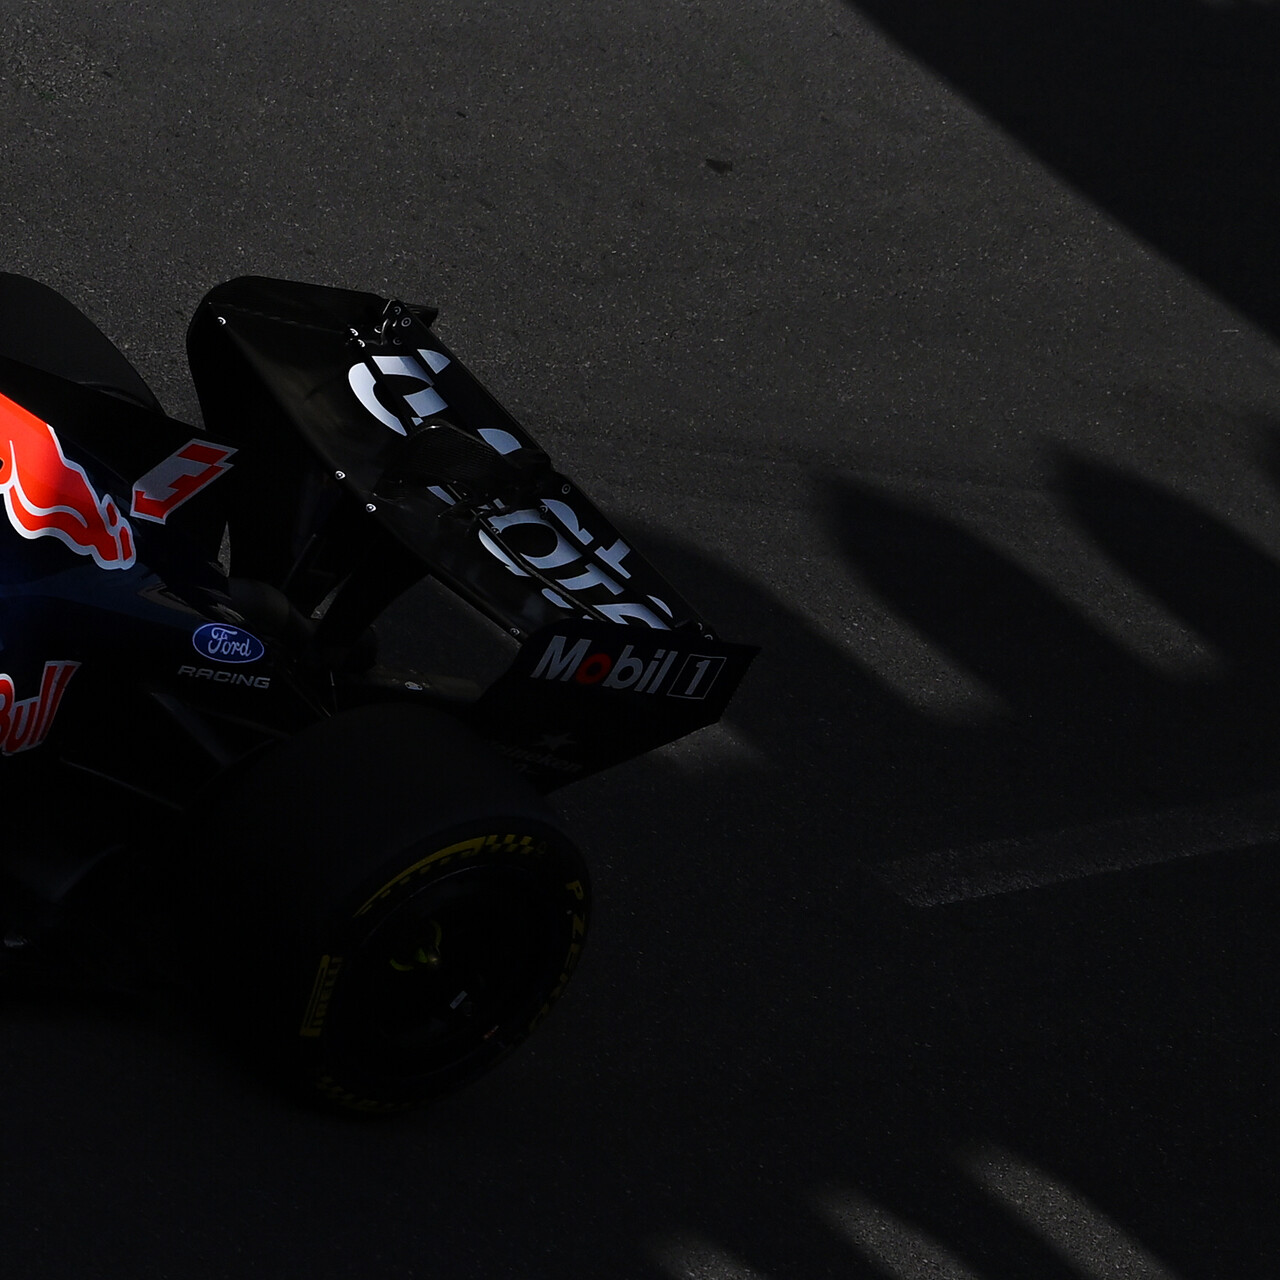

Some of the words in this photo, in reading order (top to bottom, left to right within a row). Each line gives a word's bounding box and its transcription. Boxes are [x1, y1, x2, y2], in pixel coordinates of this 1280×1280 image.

[201, 625, 258, 662] Ford
[178, 665, 271, 691] RACING
[529, 634, 673, 695] Mobil
